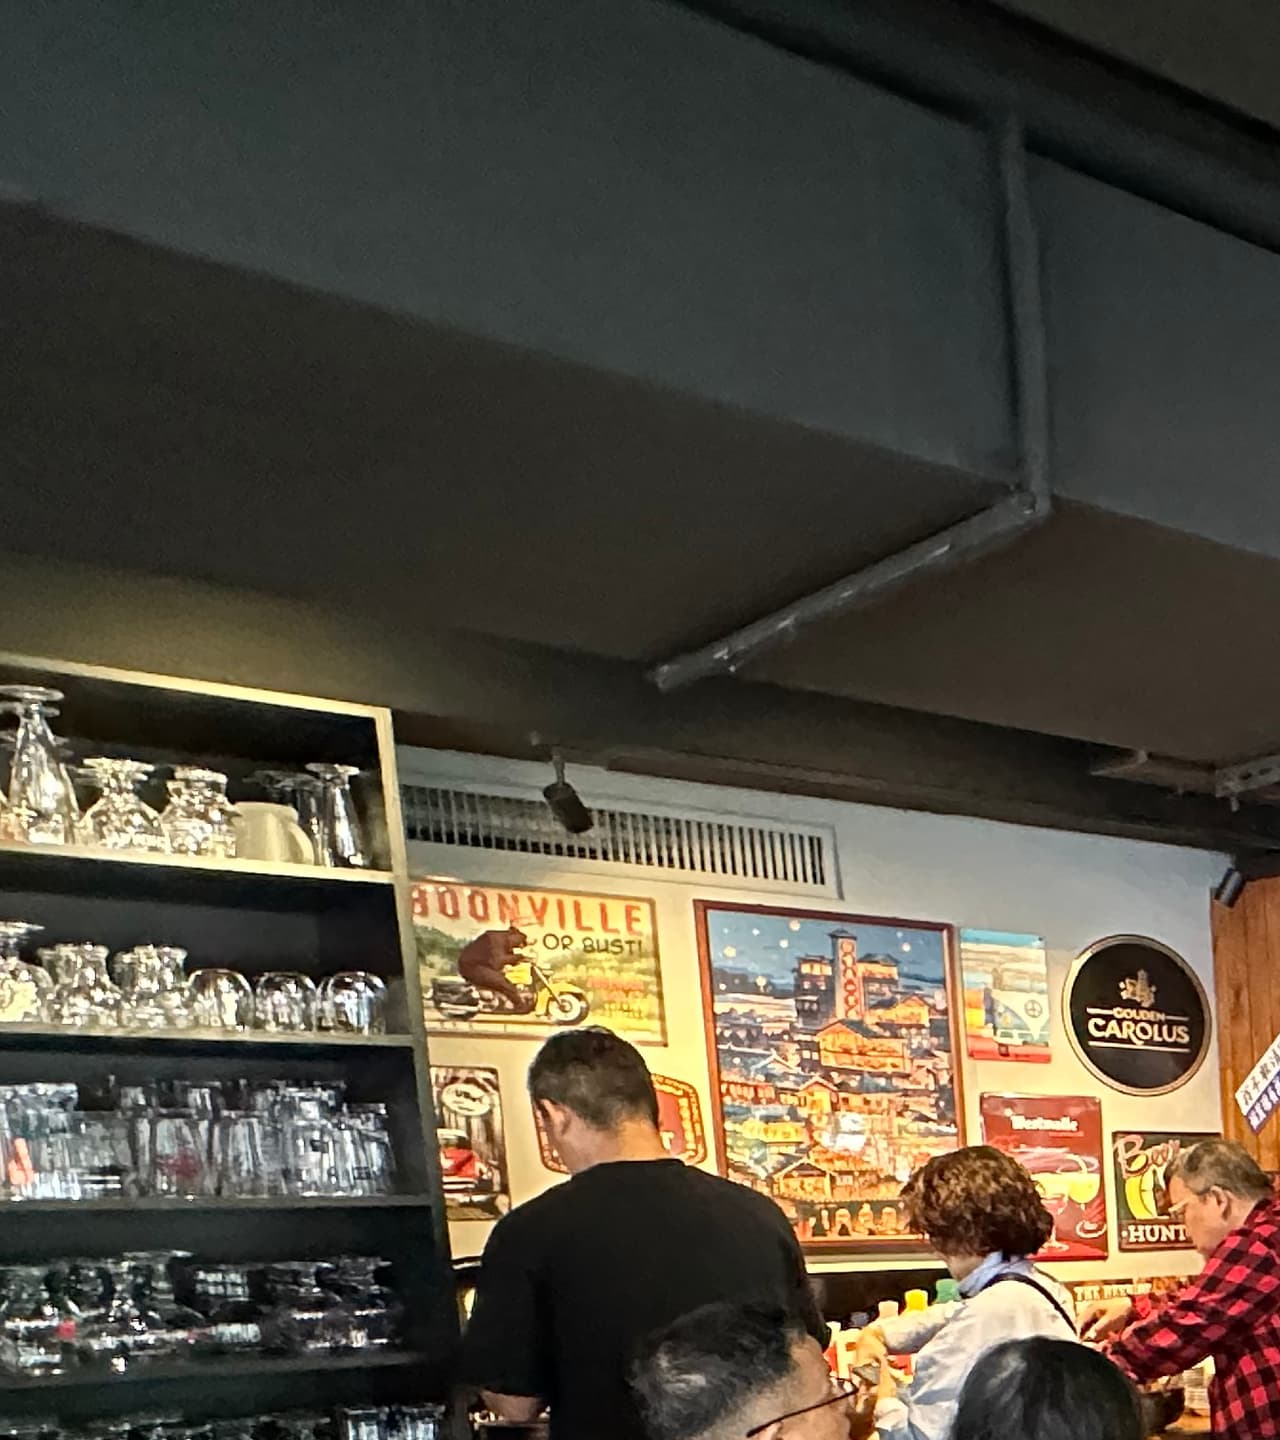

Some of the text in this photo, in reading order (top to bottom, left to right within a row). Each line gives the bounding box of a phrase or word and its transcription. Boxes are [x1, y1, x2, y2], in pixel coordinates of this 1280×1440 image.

[542, 932, 643, 956] OR BUST!
[1087, 1017, 1191, 1046] CAROLUS
